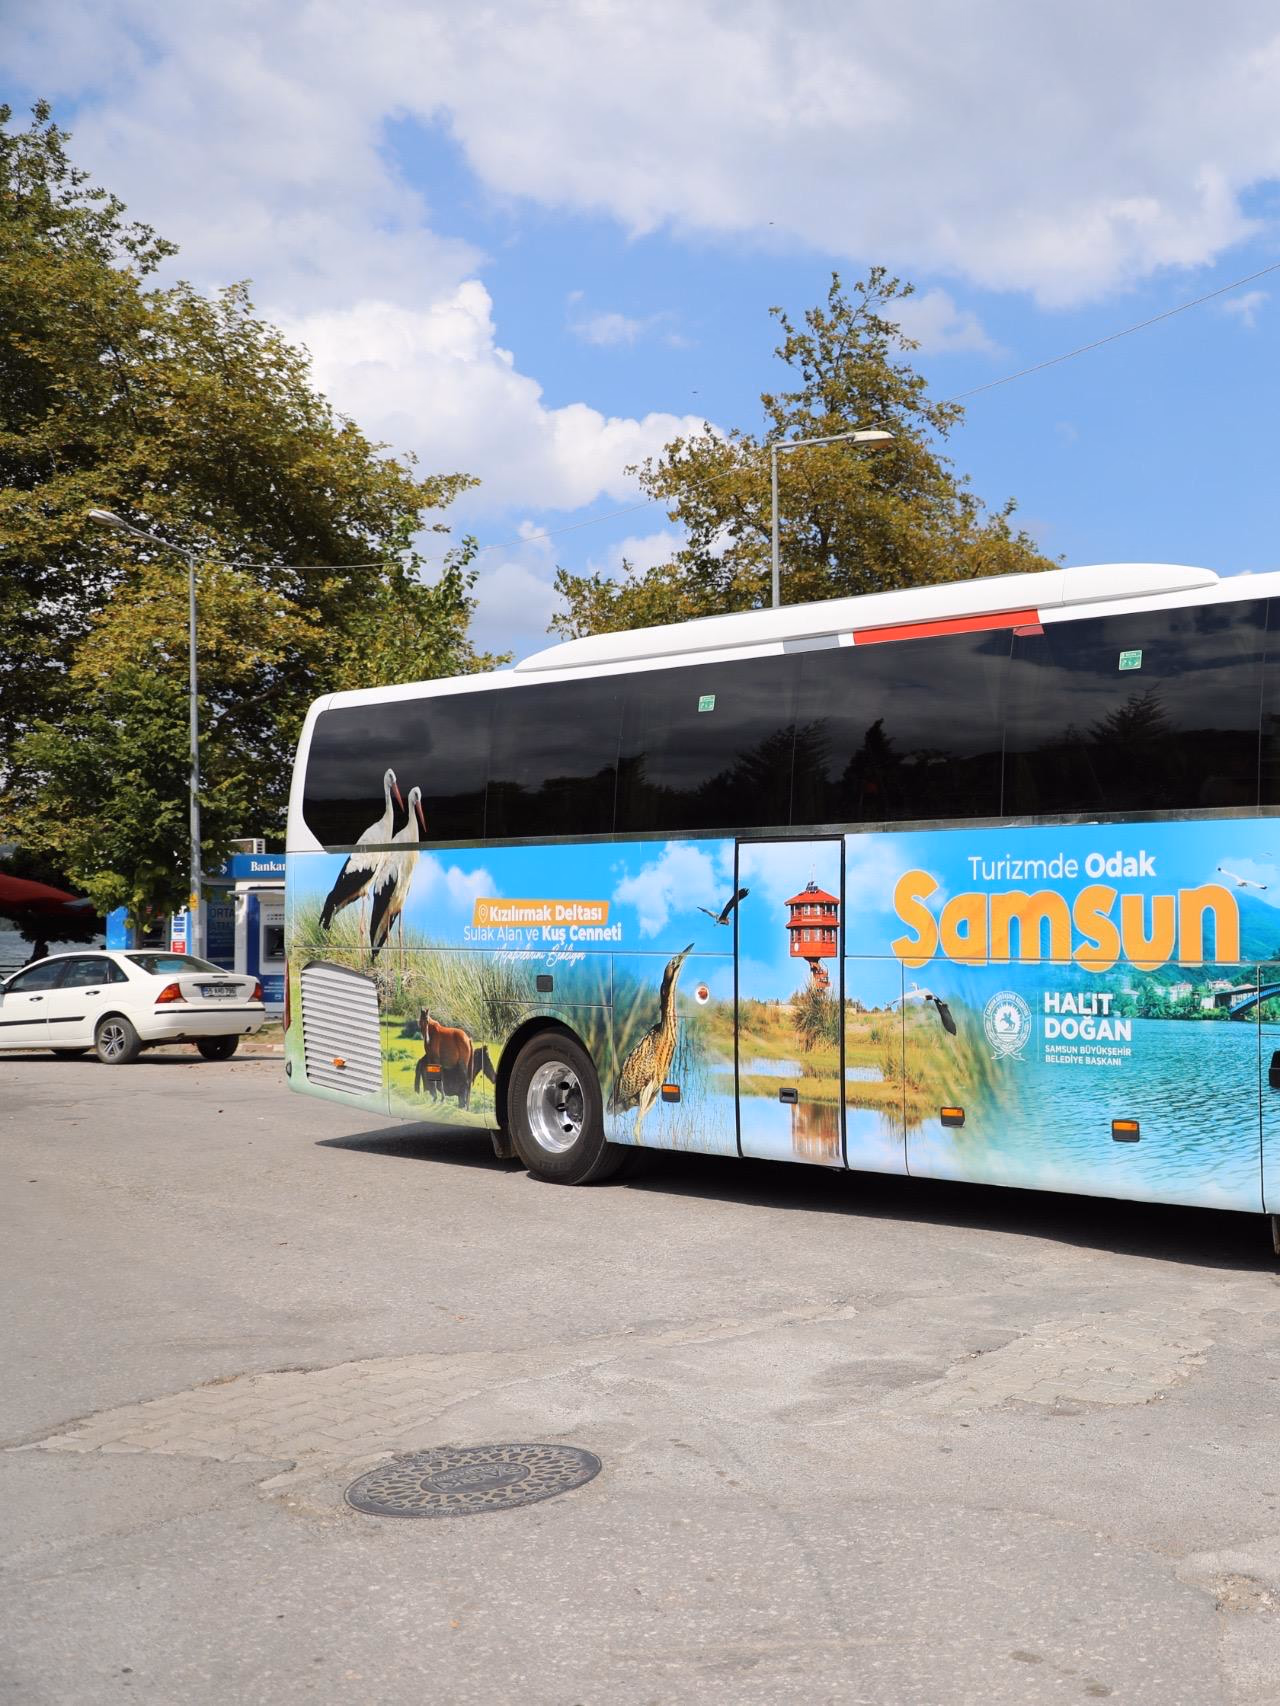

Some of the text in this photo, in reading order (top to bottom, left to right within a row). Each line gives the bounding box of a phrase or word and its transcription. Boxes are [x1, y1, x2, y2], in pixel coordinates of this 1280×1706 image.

[968, 850, 1157, 881] Turizmde Odak
[490, 904, 603, 922] Kızılırmak Deltası
[891, 869, 1241, 972] Samsun
[463, 922, 622, 946] Sulak Alan ve Kuş Cenneti
[1044, 1015, 1132, 1042] DOĞAN
[1045, 1044, 1132, 1057] SAMSUN BÜYÜKŞEHİR
[1045, 1055, 1122, 1066] BELEDİYE BAŞKANI
